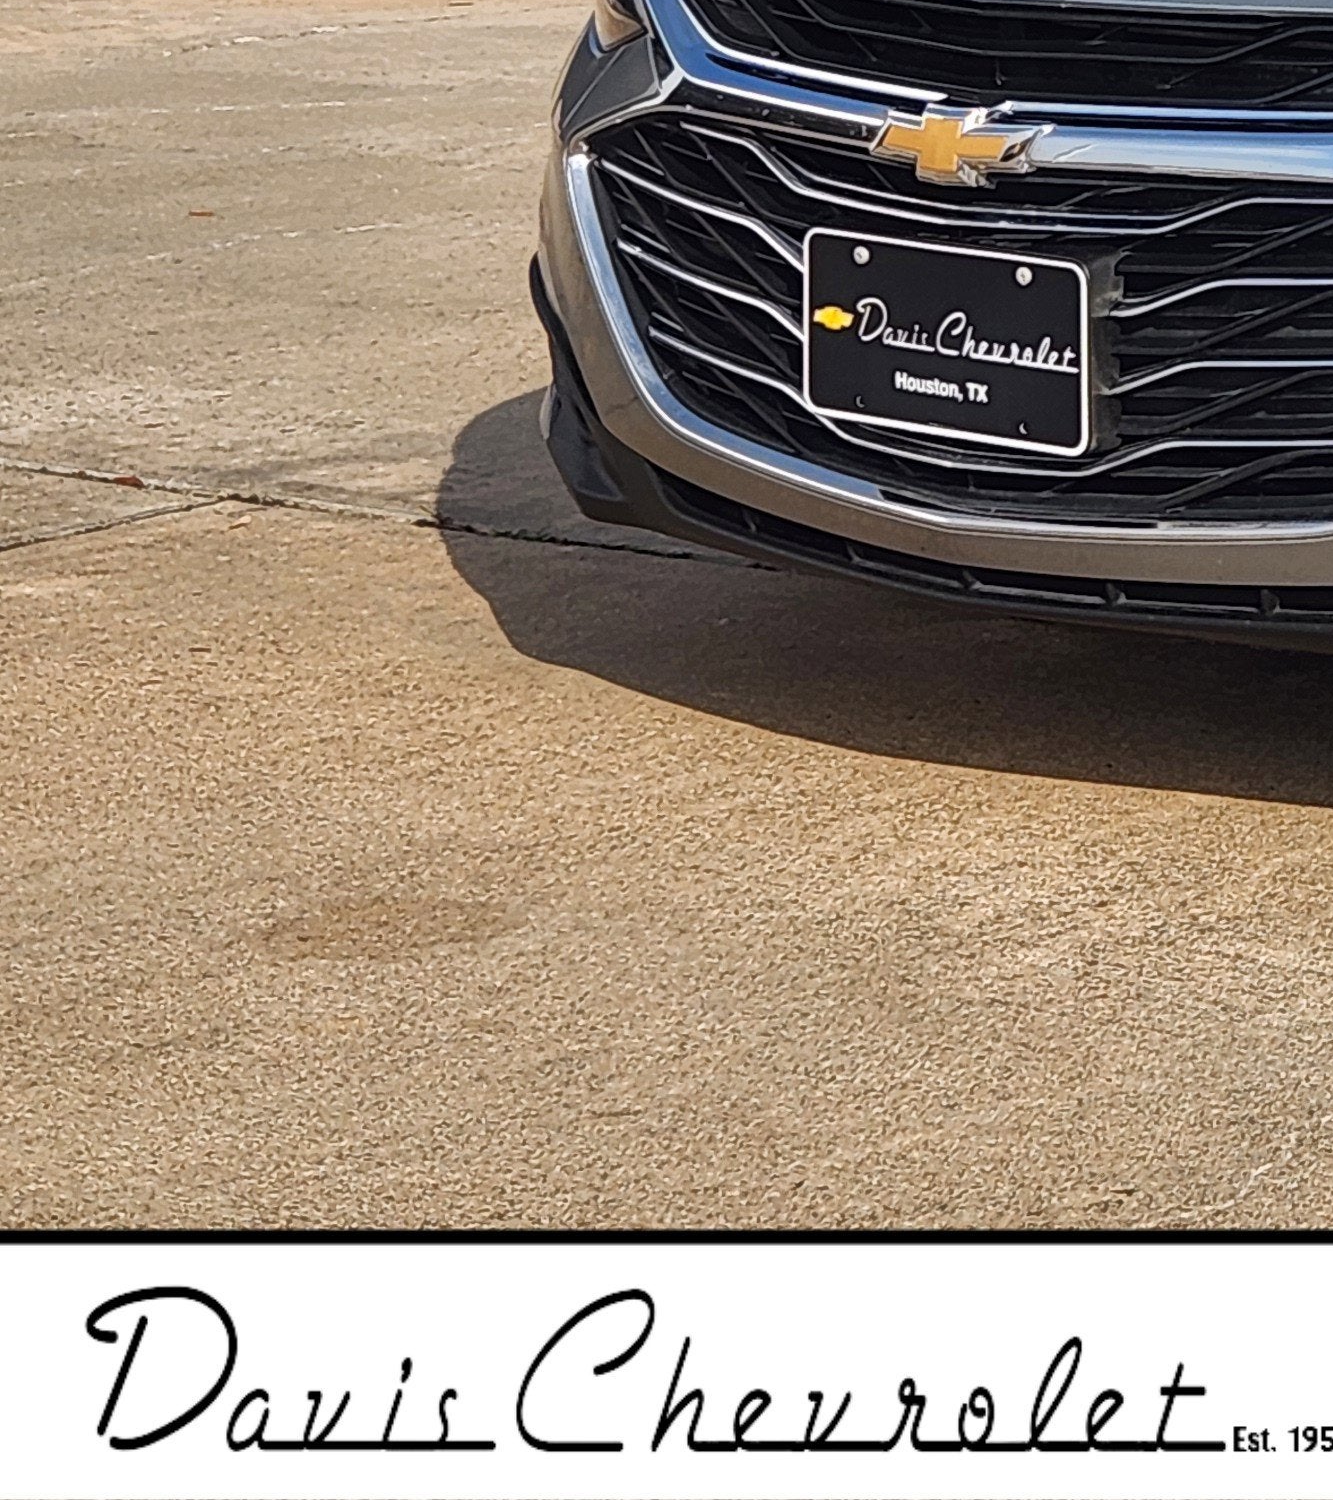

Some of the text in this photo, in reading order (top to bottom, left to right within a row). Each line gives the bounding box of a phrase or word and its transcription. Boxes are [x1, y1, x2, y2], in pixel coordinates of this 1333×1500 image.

[855, 296, 1080, 374] Davis Chevrolet
[894, 370, 989, 404] Houston, TX
